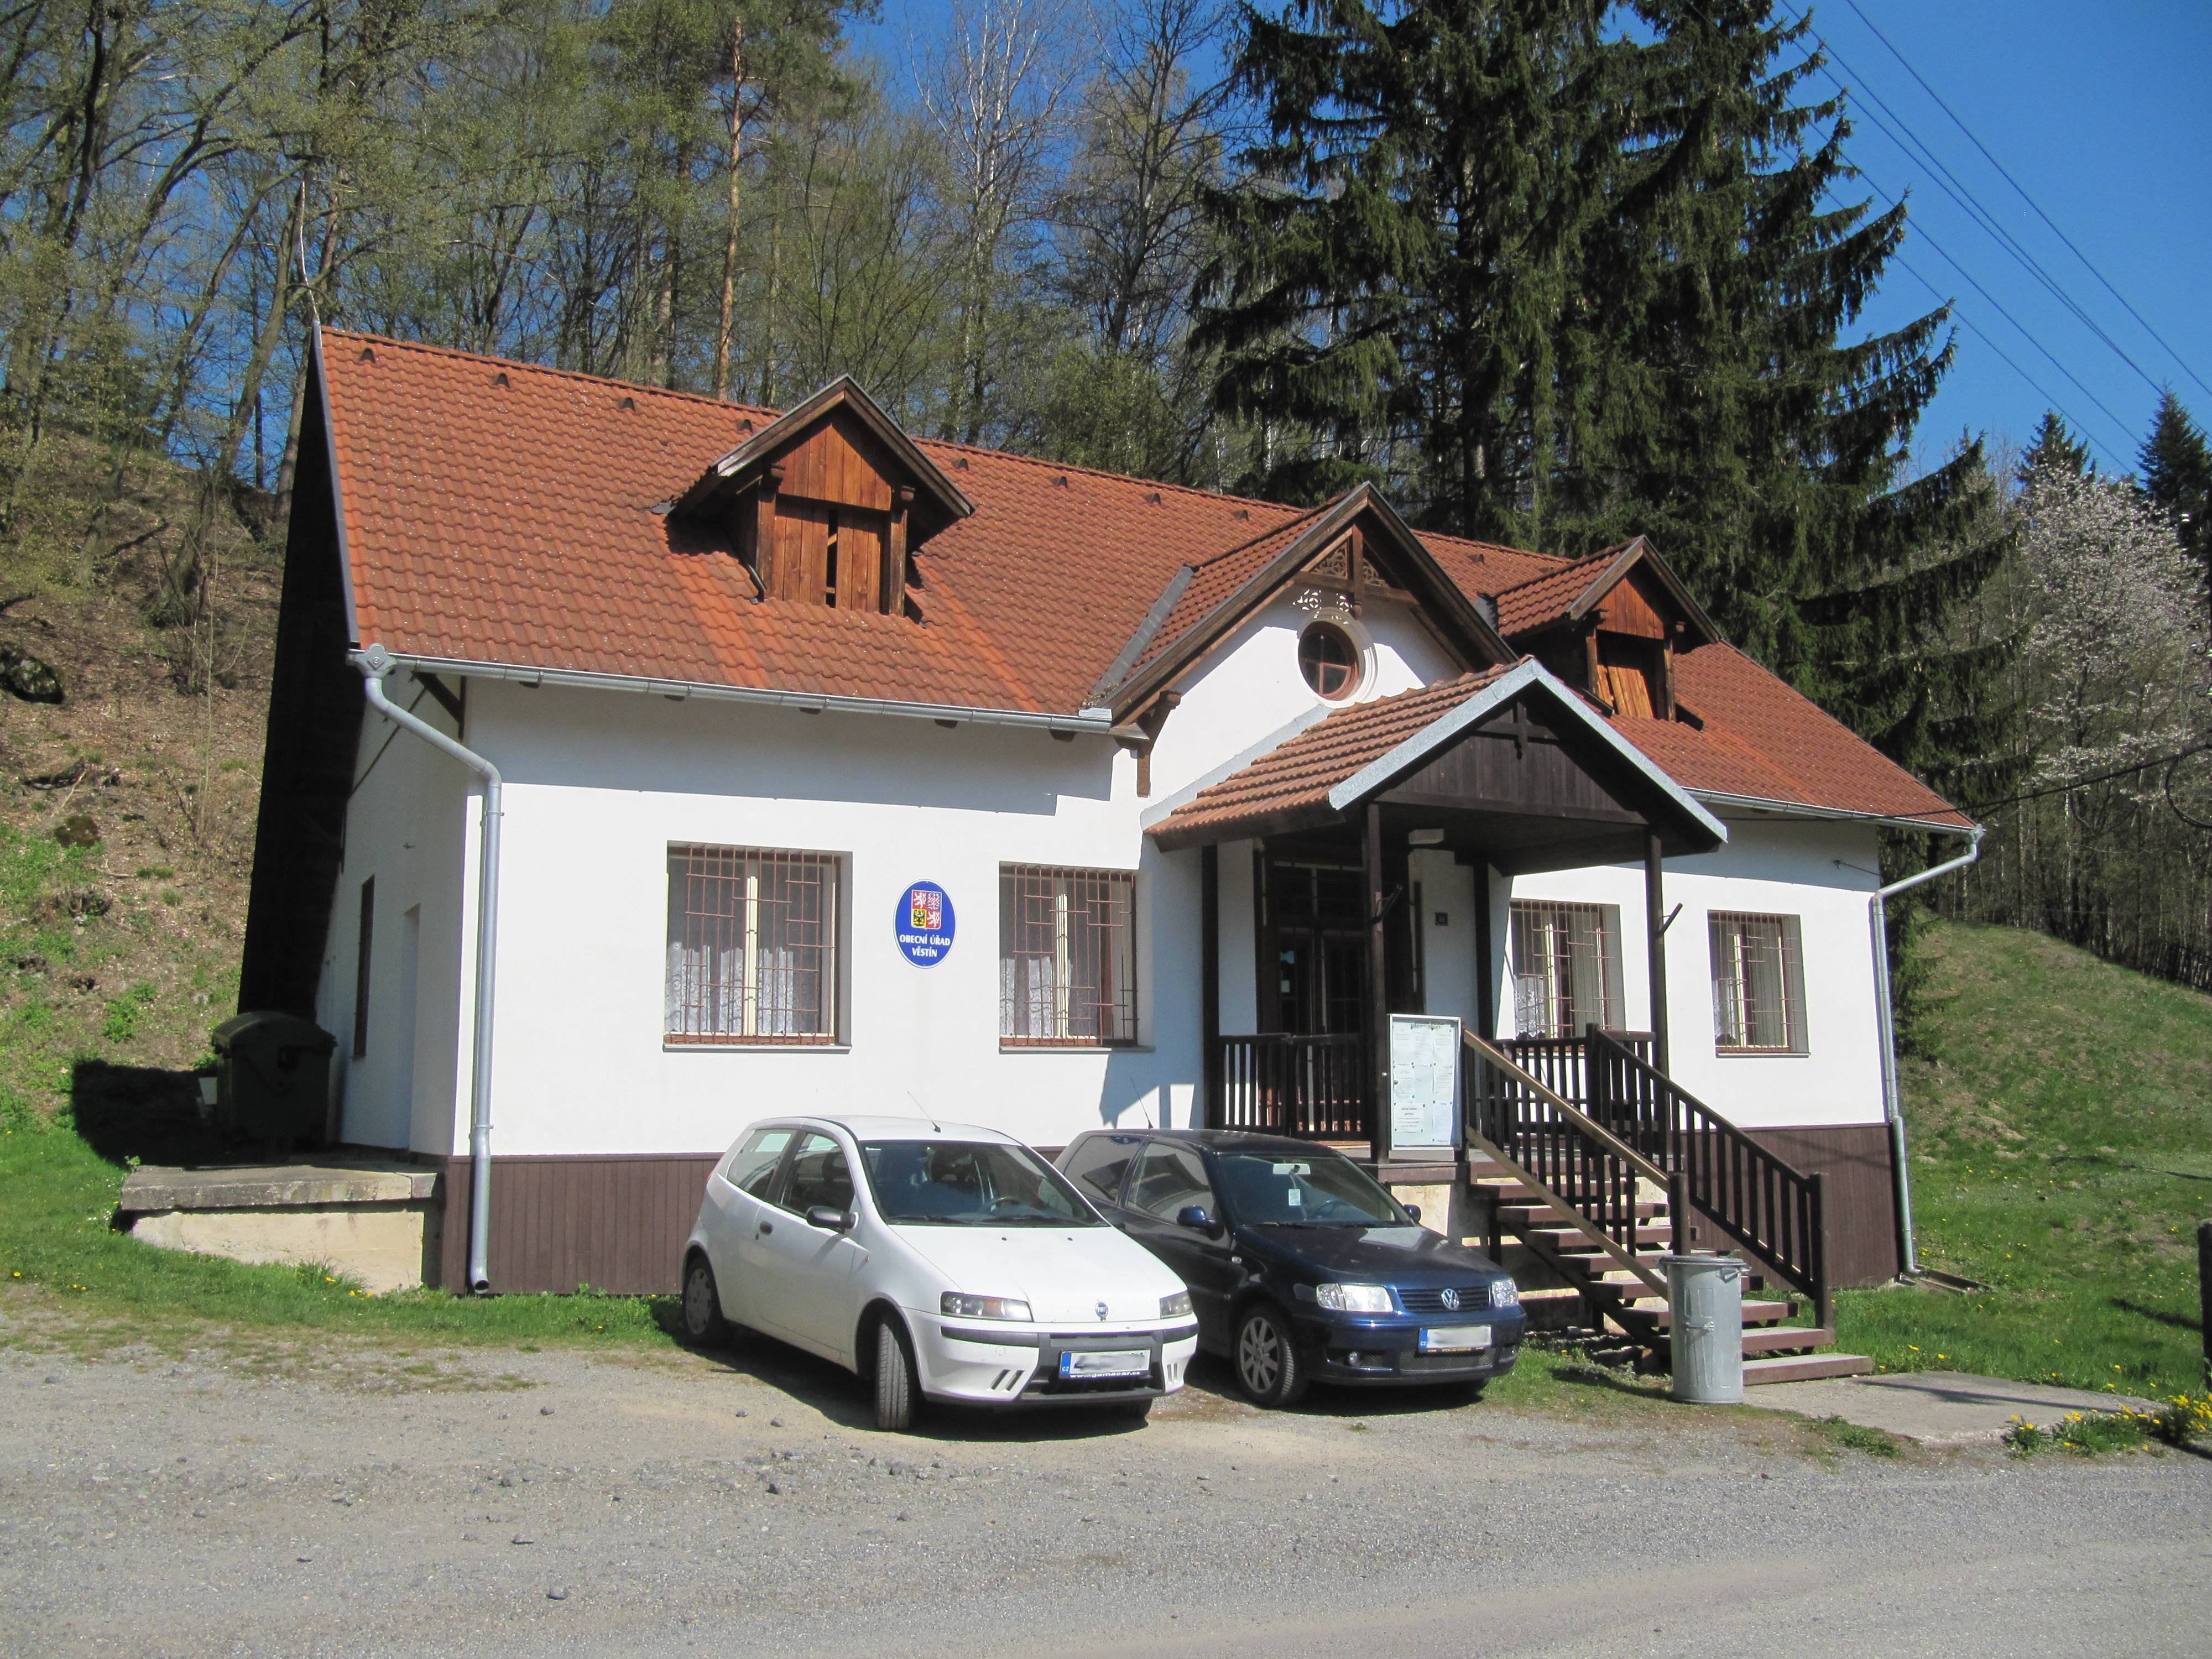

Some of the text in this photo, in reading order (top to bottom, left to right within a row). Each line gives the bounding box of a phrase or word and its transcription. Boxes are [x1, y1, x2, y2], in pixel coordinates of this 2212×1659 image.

[899, 933, 951, 946] OBECNÍ ÚŘAD
[911, 946, 938, 957] VĚSTÍN
